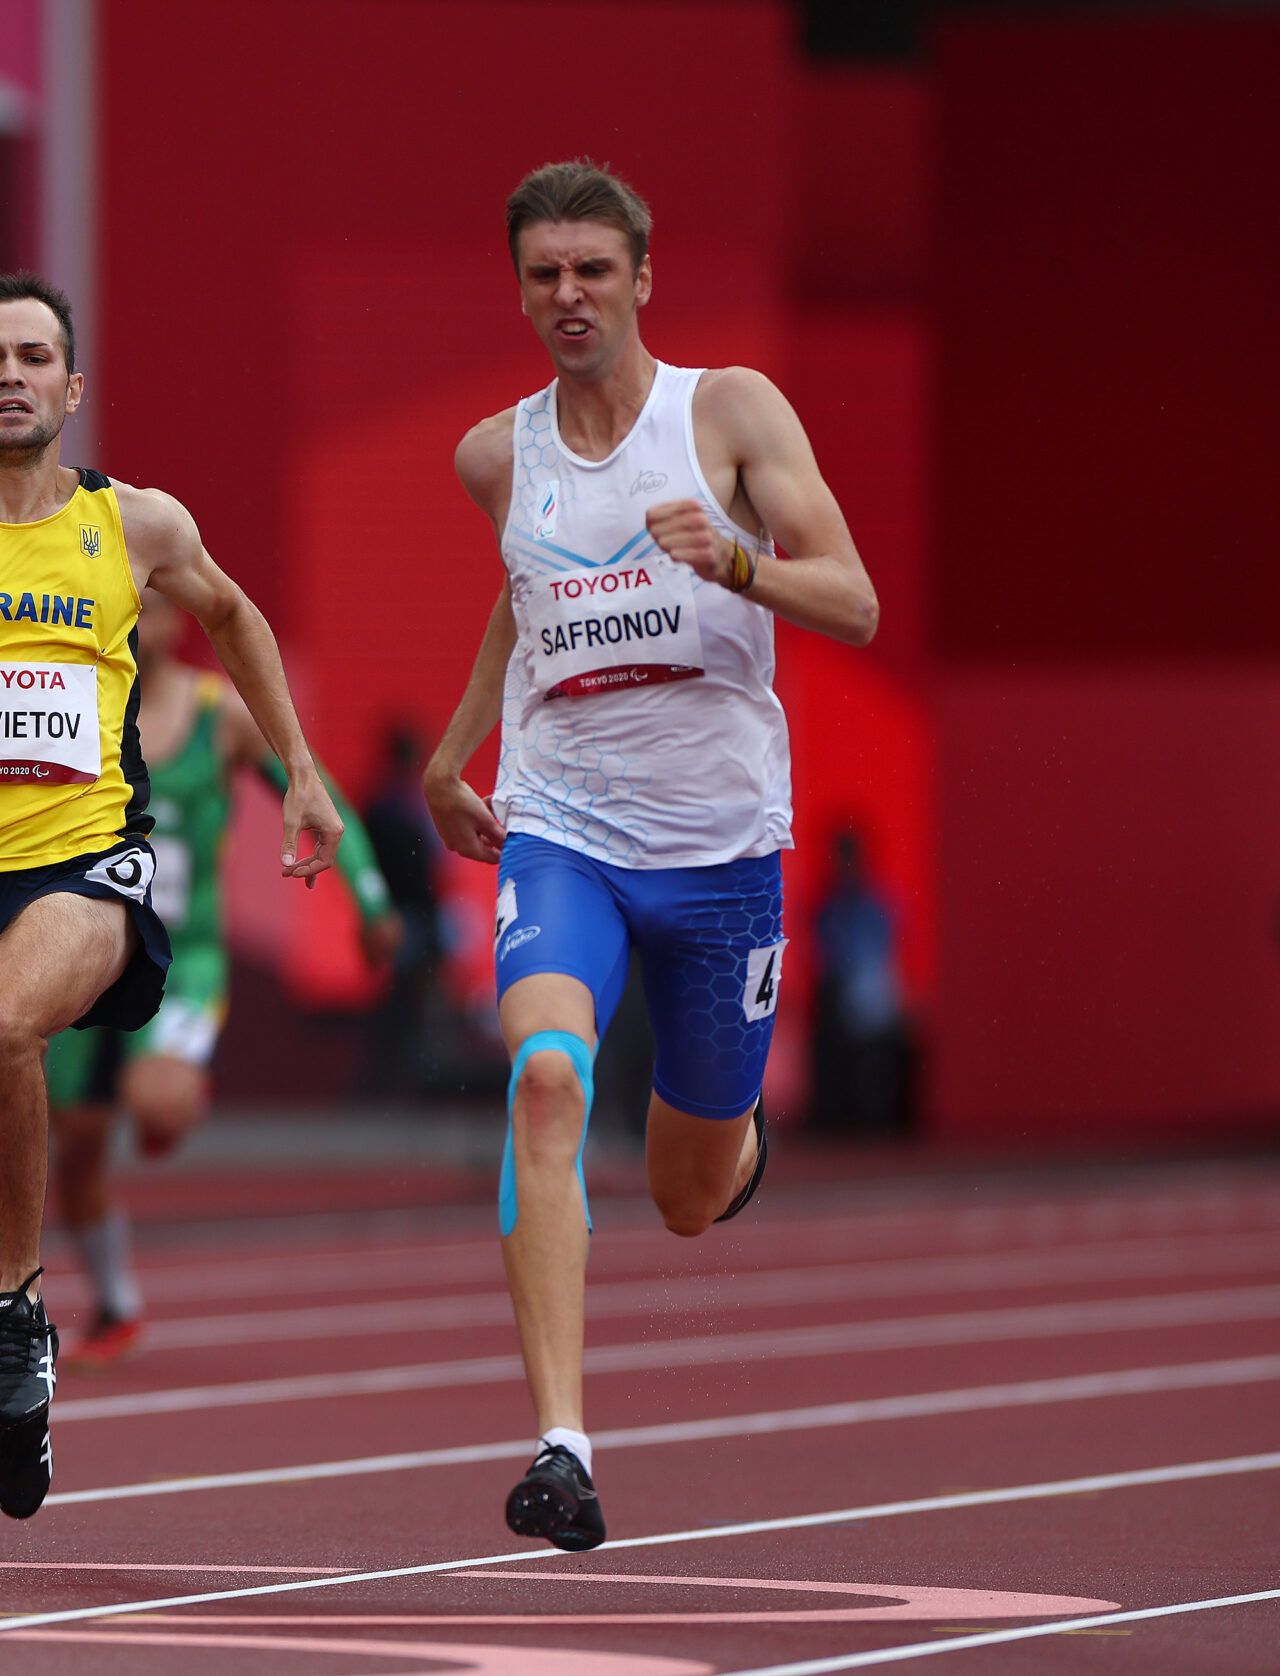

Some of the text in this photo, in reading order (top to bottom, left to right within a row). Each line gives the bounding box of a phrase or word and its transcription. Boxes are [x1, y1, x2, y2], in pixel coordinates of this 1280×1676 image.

[549, 568, 652, 601] TOYOTA
[541, 605, 681, 656] SAFRONOV
[579, 672, 629, 688] TOKYO 2020
[10, 766, 30, 775] 2020
[755, 950, 776, 1010] 4
